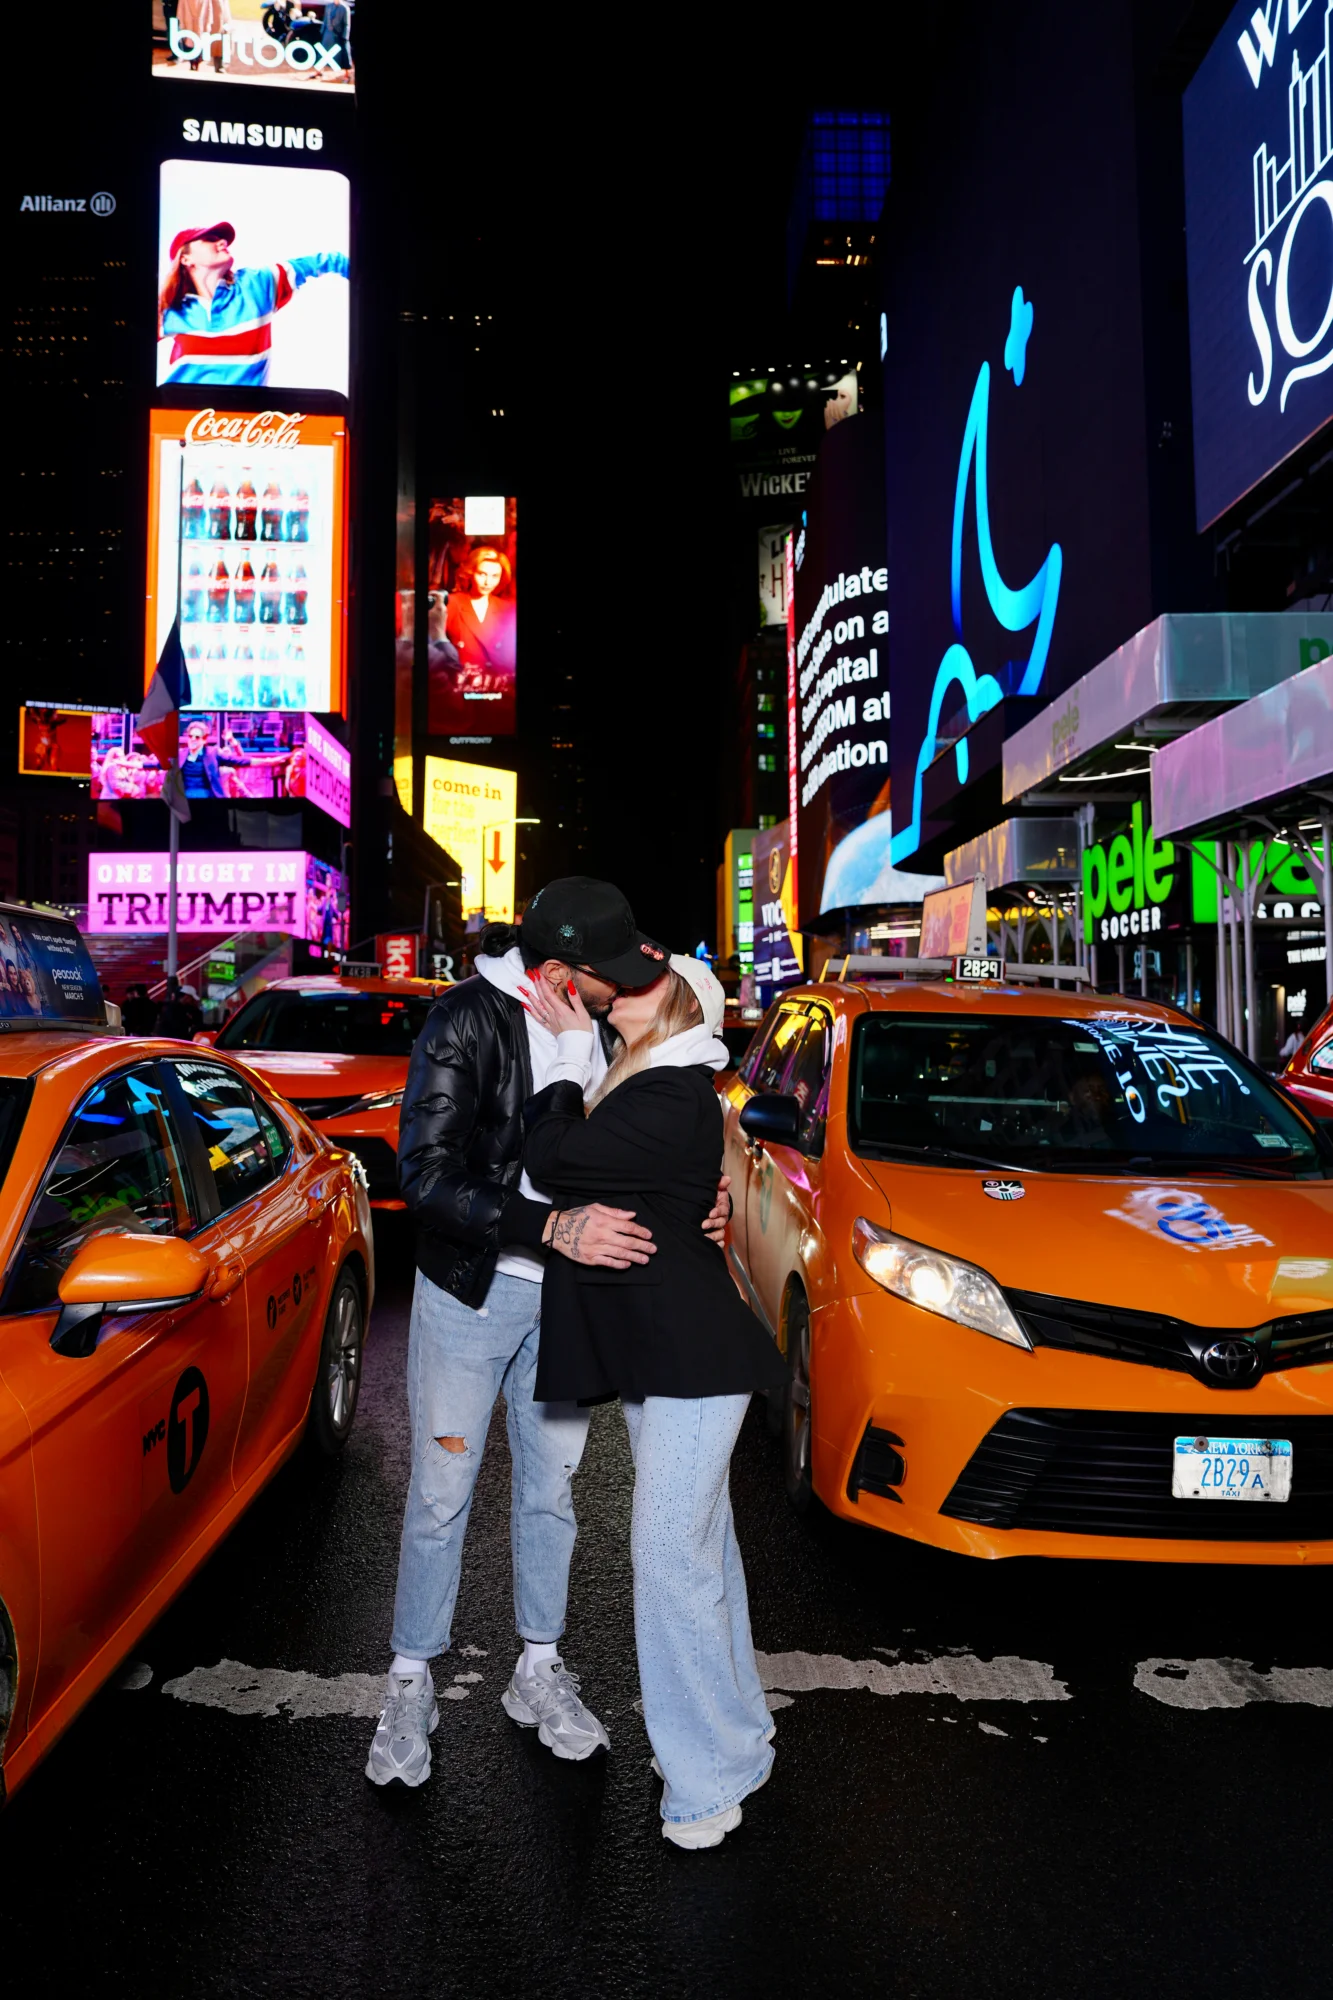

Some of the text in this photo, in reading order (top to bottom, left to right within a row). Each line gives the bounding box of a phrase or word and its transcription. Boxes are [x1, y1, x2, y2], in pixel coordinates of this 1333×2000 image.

[169, 18, 342, 72] britbox
[182, 118, 324, 151] SAMSUNG
[20, 195, 87, 212] Allianz
[184, 408, 307, 449] Coca-Cola
[738, 471, 812, 498] WICKE
[834, 614, 865, 645] on
[872, 610, 889, 635] a
[862, 691, 890, 722] at
[432, 777, 504, 801] come in
[97, 862, 297, 883] ONE NIGHT IN
[97, 891, 297, 925] TRIUMPH
[1101, 906, 1161, 941] SOCCER
[52, 966, 83, 985] peacock
[963, 960, 998, 978] 2B29
[64, 991, 80, 1000] MARCH
[142, 1418, 166, 1457] NYC
[1204, 1443, 1229, 1454] NEW
[1221, 1489, 1241, 1497] TAXI
